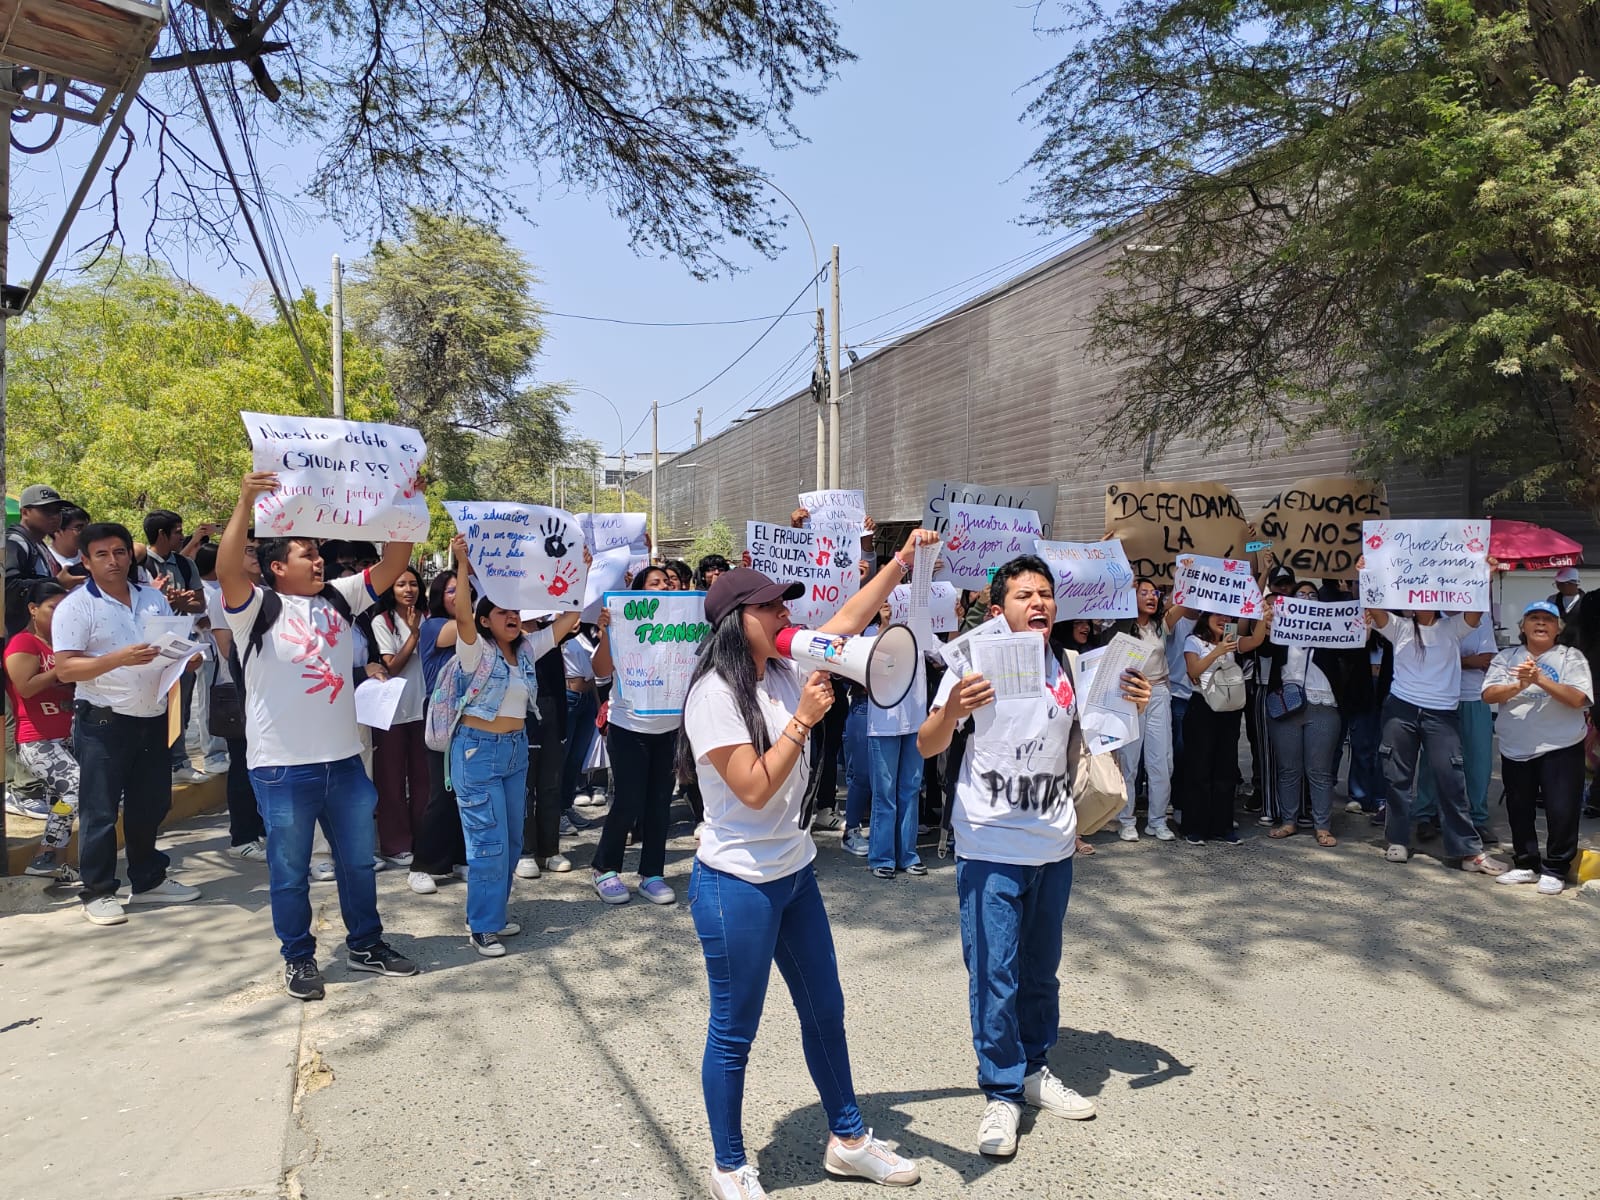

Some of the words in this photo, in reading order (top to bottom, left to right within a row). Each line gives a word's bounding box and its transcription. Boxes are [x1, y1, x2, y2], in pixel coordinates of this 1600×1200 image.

[259, 423, 329, 441] Nuestro
[345, 430, 388, 448] delito
[400, 443, 418, 453] es
[347, 486, 385, 507] puntaje
[826, 510, 847, 521] UNA
[958, 511, 1009, 535] Nuestra
[468, 524, 480, 539] NO
[481, 531, 490, 541] es
[494, 531, 506, 540] un
[755, 525, 769, 540] EL
[774, 528, 814, 545] FRAUDE
[1164, 526, 1195, 553] LA
[752, 542, 765, 555] SE
[978, 540, 1003, 558] por
[1007, 537, 1021, 552] la
[1394, 532, 1465, 556] Nuestra
[479, 546, 502, 565] fraude
[506, 548, 525, 558] debe
[1271, 549, 1363, 573] VEND
[1419, 557, 1437, 567] es
[1549, 555, 1573, 566] Cash
[752, 559, 778, 573] PERO
[782, 564, 831, 579] NUESTRA
[1201, 572, 1217, 584] NO
[1219, 576, 1230, 588] ES
[1232, 578, 1246, 590] MI
[1391, 573, 1429, 590] fuerte
[1437, 576, 1458, 587] que
[1463, 579, 1488, 588] sus
[812, 584, 839, 602] NO
[1408, 590, 1472, 604] MENTIRAS
[623, 598, 660, 621] UNP
[1278, 616, 1332, 632] JUSTICIA
[1344, 621, 1353, 632] Y
